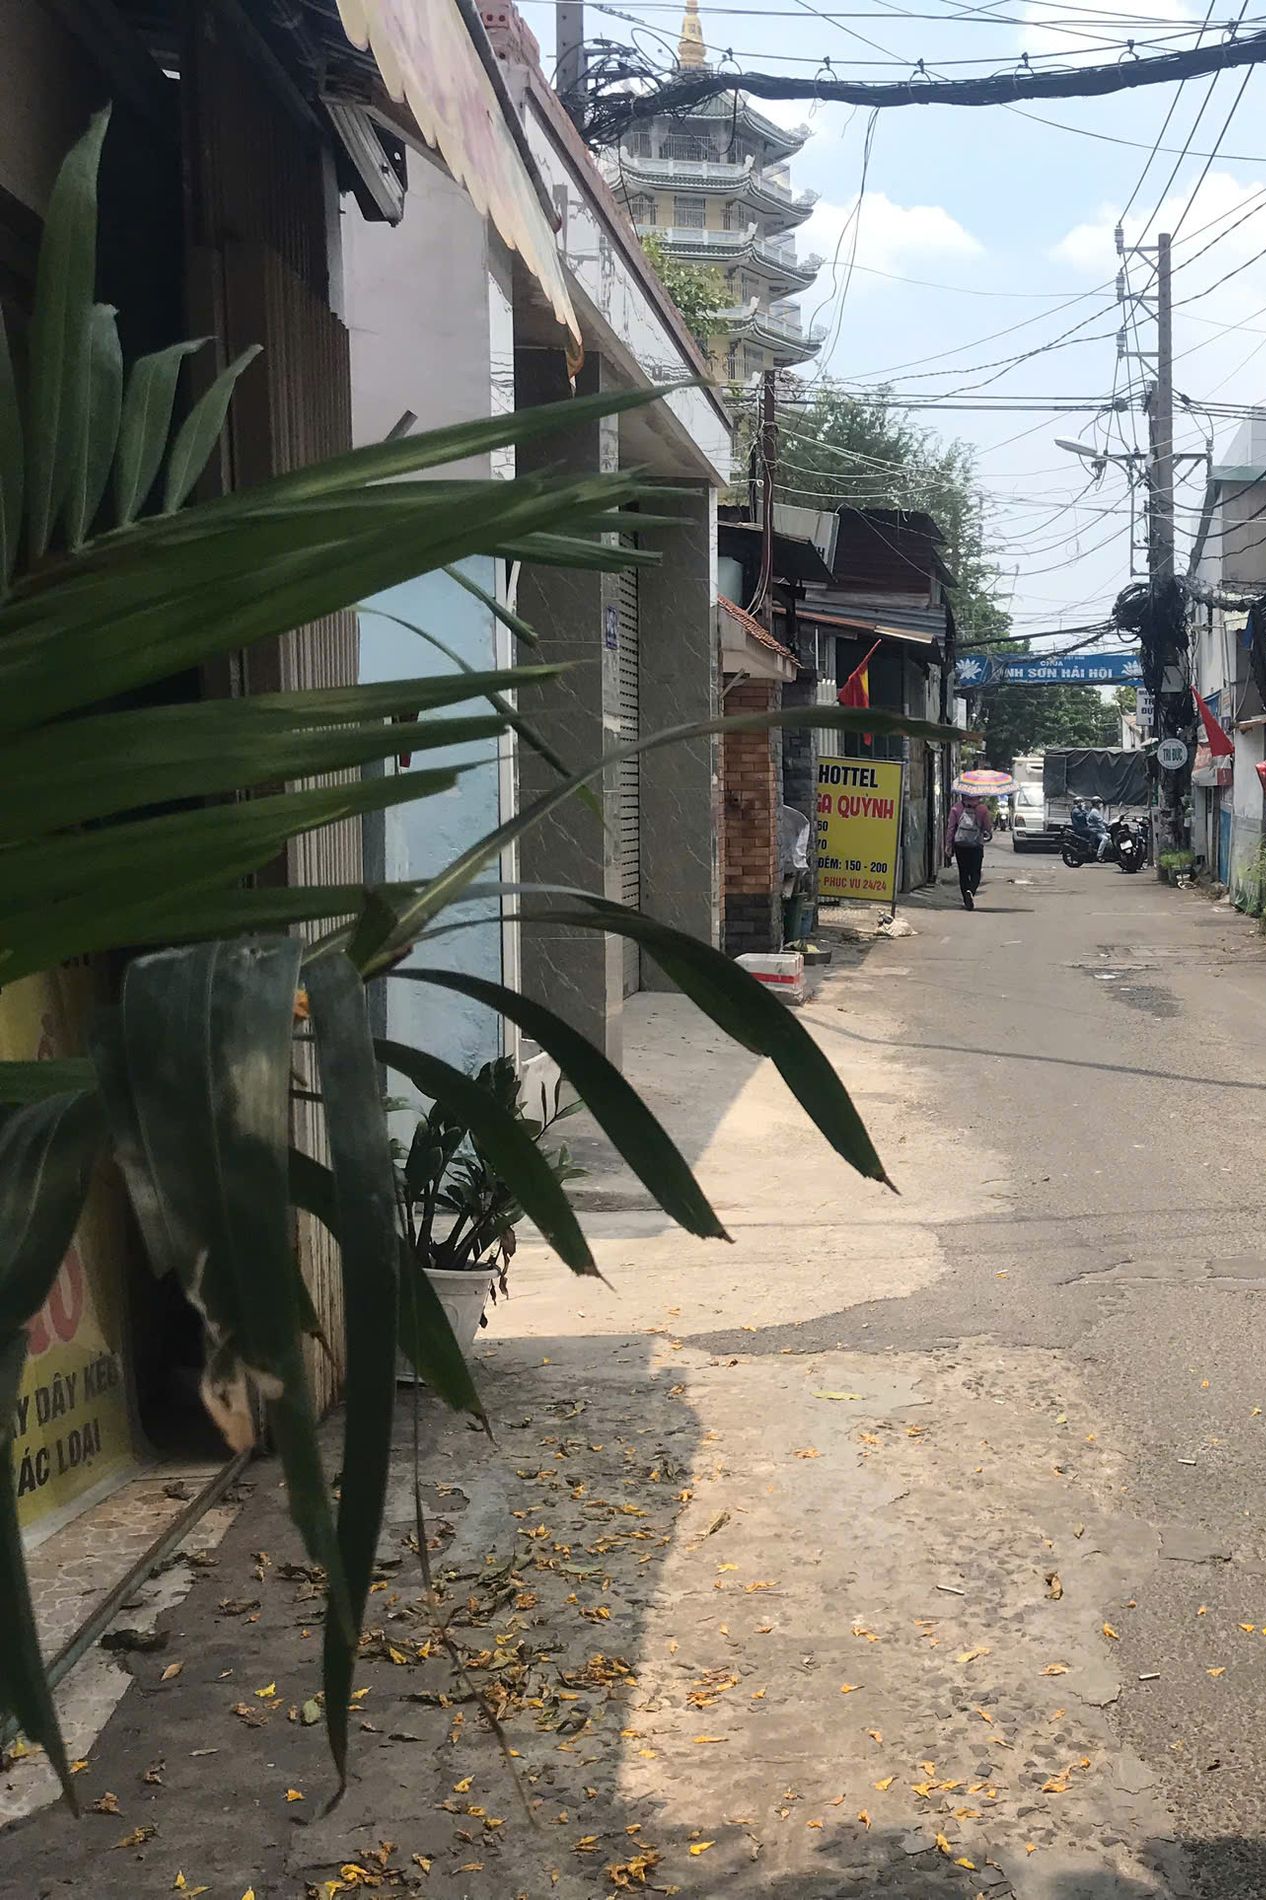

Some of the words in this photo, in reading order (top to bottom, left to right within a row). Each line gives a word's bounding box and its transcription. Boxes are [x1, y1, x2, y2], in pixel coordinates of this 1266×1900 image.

[818, 764, 879, 788] HOTTEL
[837, 793, 895, 820] QUỲNH
[845, 860, 861, 871] 150
[870, 862, 888, 873] 200
[35, 1371, 76, 1428] DÂY
[17, 1445, 50, 1498] ÁC
[56, 1417, 102, 1476] LOẠI
